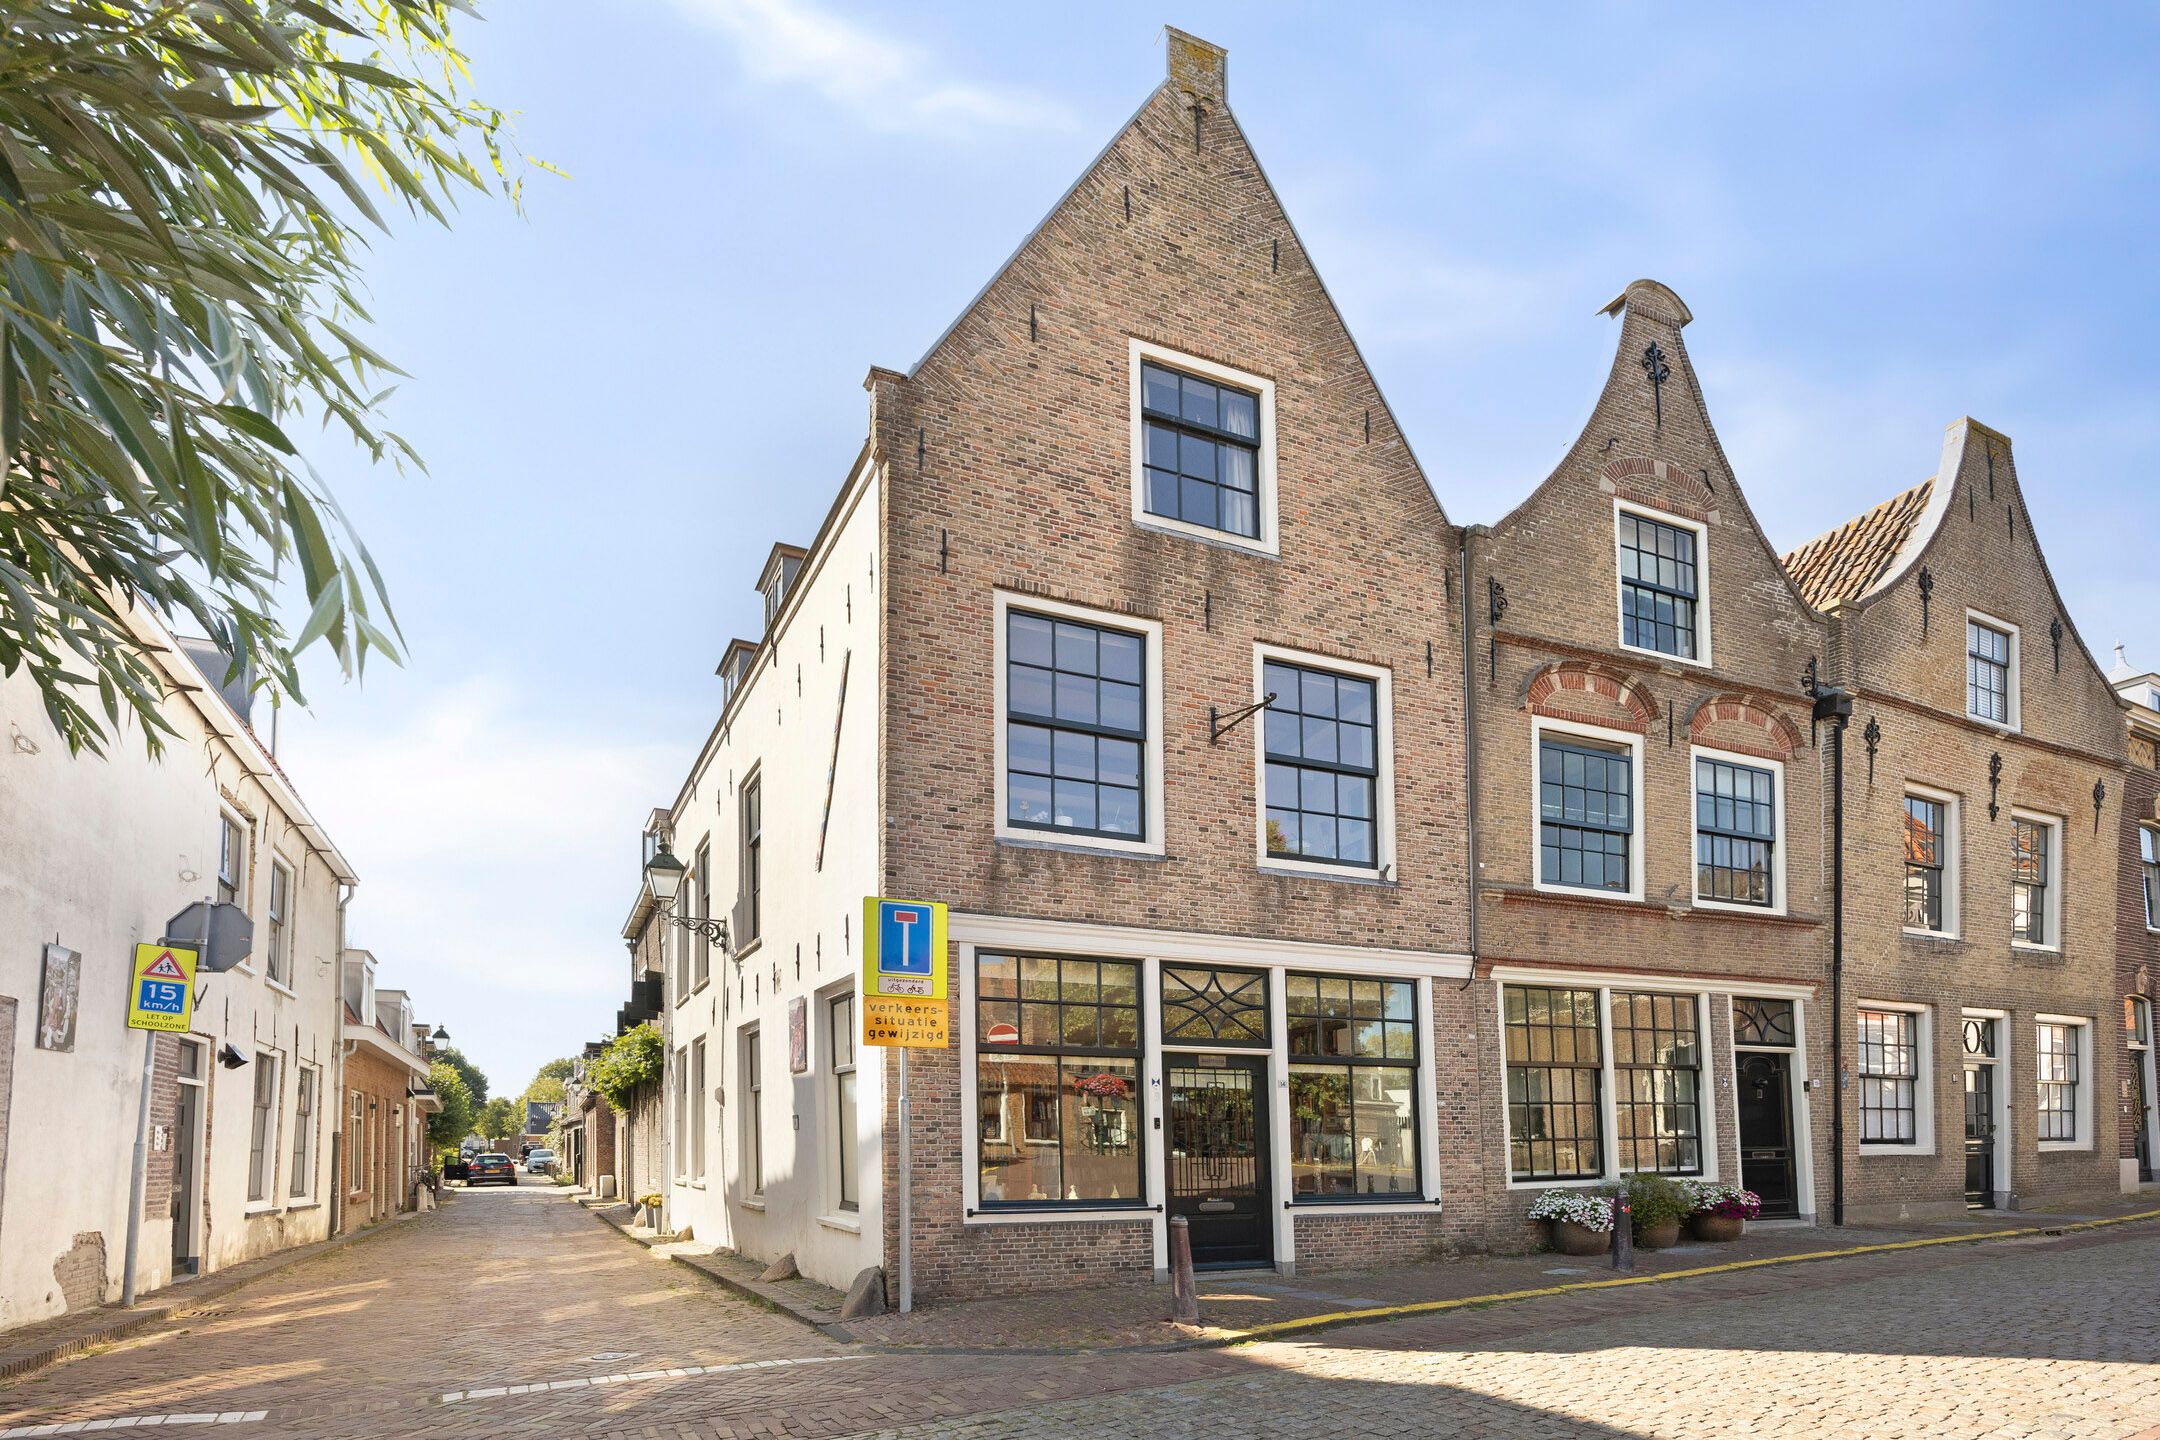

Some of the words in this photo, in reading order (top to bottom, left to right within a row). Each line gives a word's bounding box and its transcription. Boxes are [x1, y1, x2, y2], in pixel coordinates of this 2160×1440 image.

[149, 983, 177, 1000] 15
[143, 1000, 180, 1011] km/h
[869, 1003, 943, 1014] verkeers-
[130, 1019, 187, 1030] SCHOOLZONE
[875, 1016, 937, 1027] situatie
[868, 1029, 943, 1042] gewijzigd
